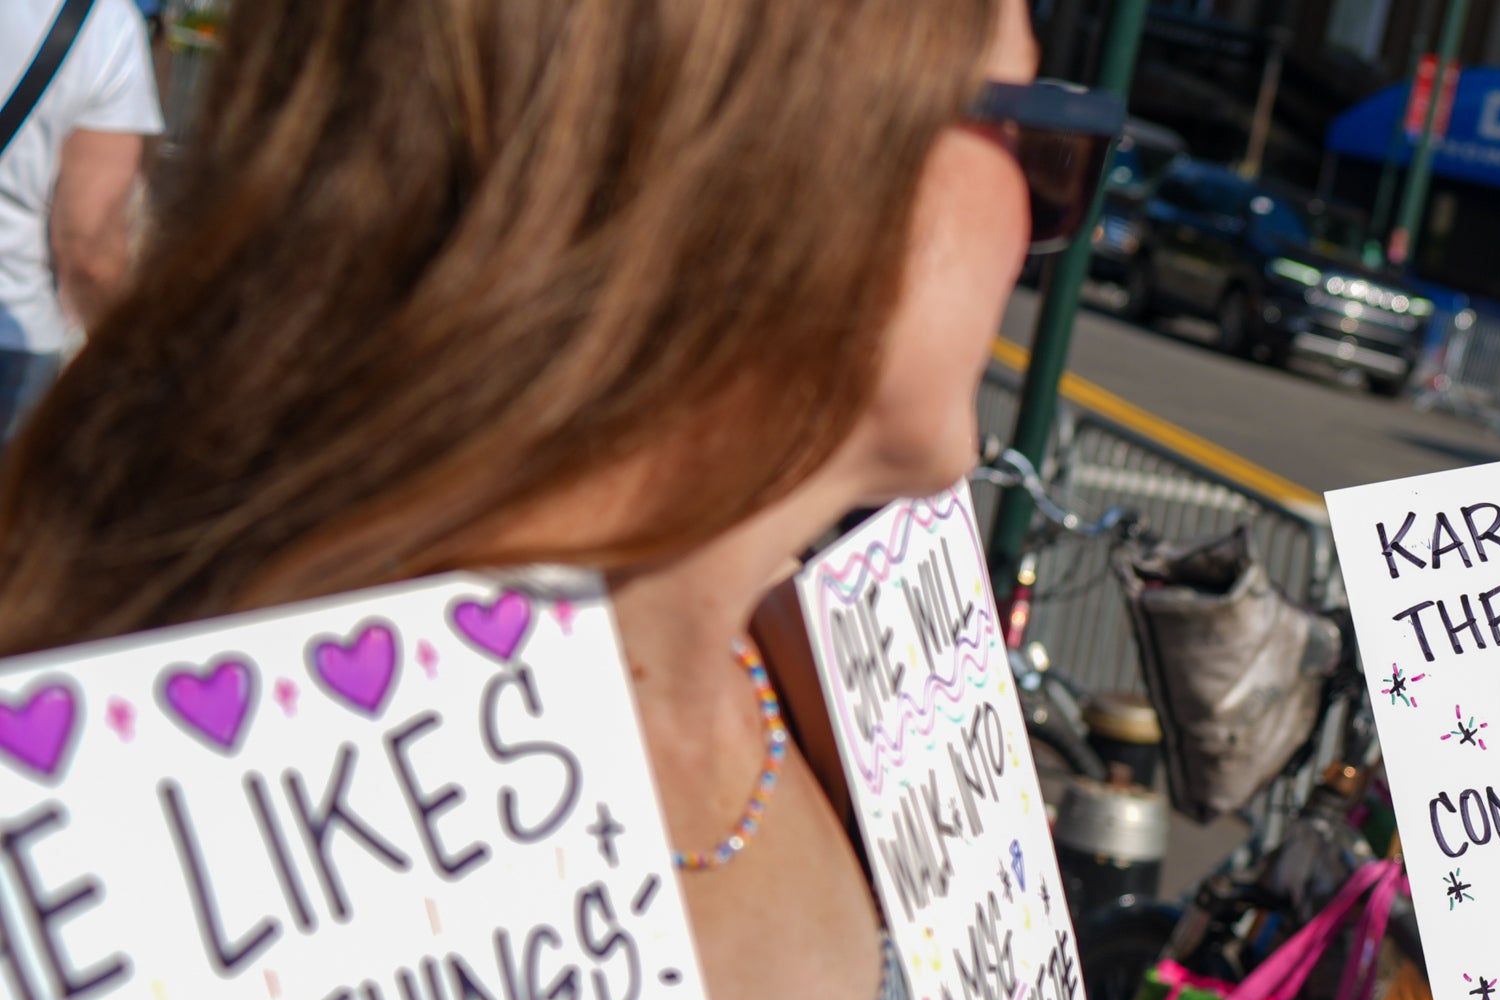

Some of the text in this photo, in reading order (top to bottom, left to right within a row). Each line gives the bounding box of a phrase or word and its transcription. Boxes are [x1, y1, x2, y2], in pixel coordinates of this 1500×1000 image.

[830, 536, 974, 743] SHE WILL
[156, 664, 584, 975] LIKES
[877, 702, 1005, 922] WALK INTO
